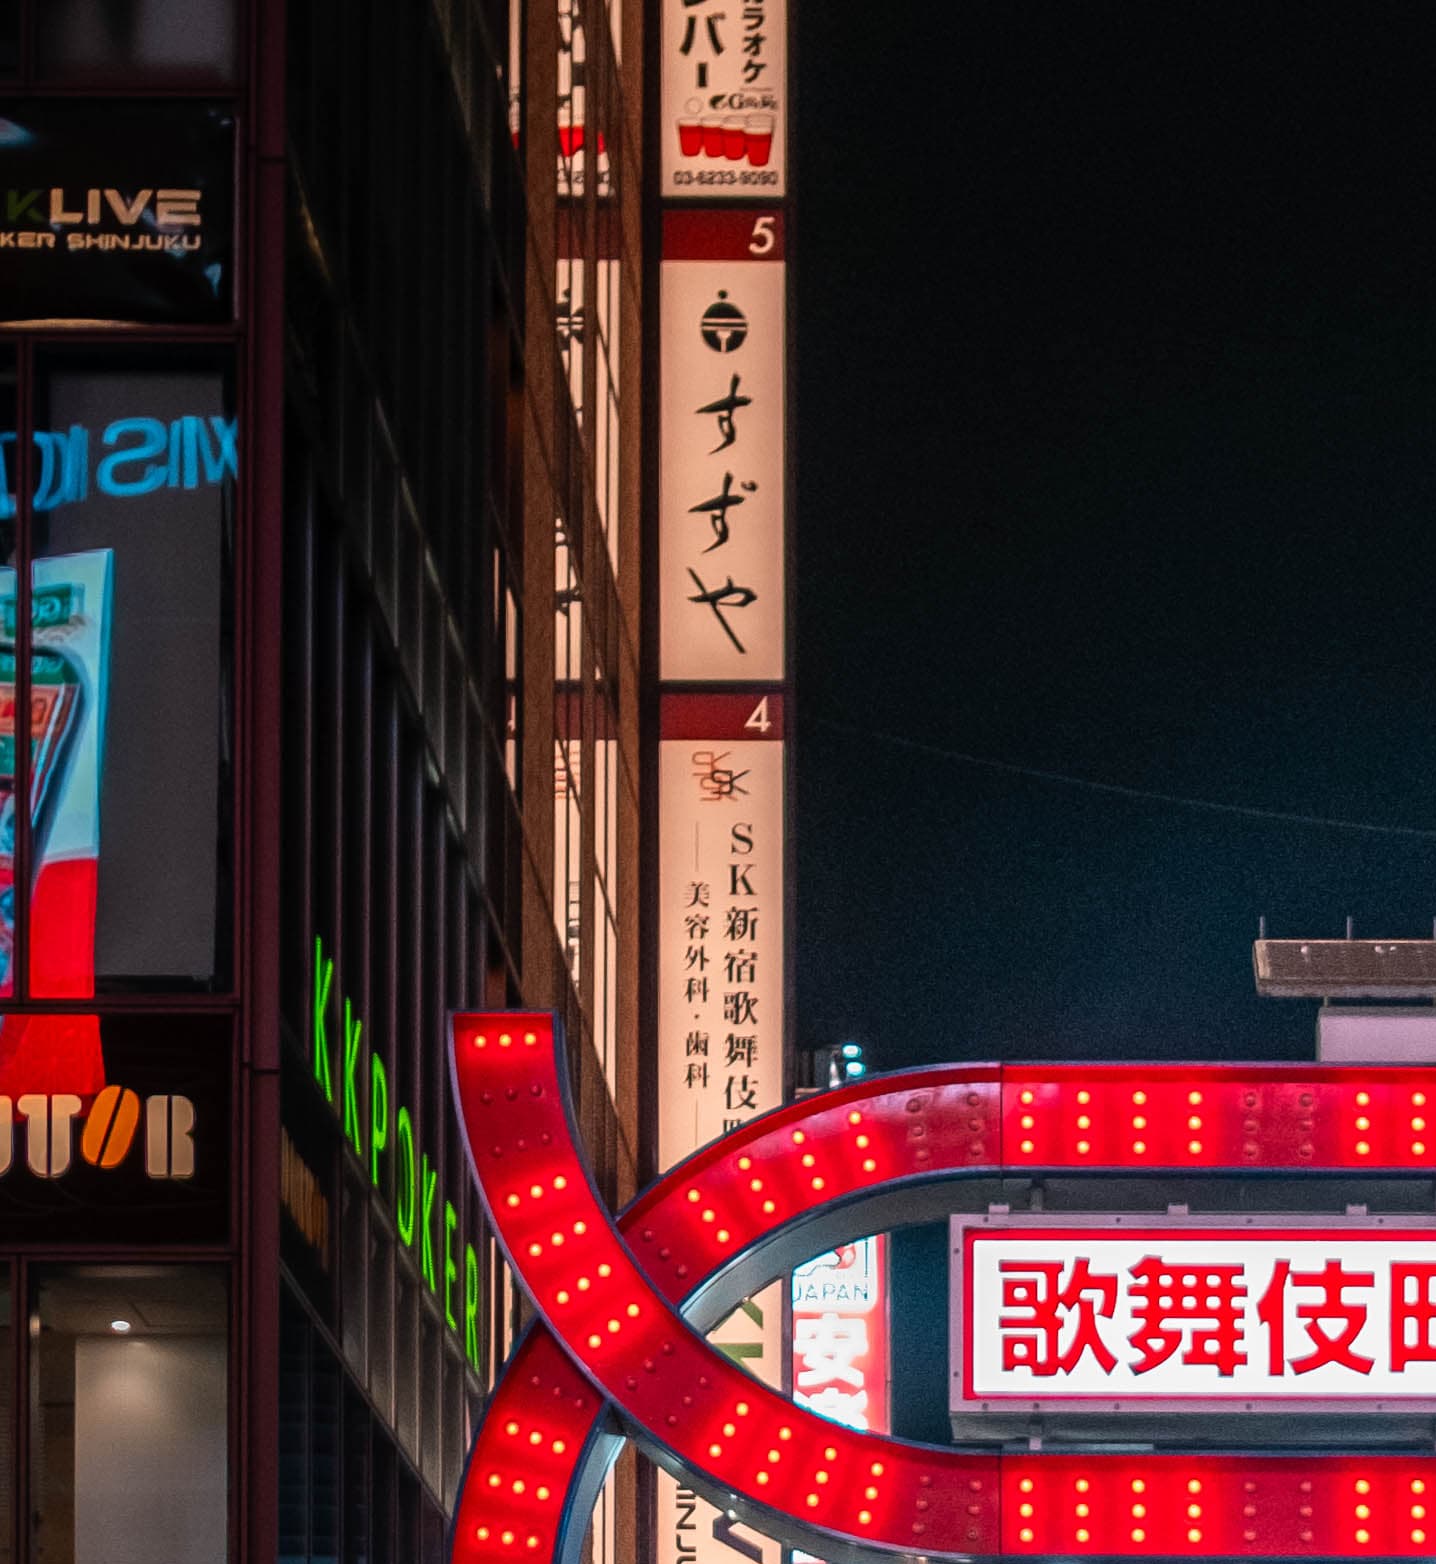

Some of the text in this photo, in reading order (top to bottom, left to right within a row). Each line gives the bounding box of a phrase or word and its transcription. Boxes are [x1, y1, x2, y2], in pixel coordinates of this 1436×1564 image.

[680, 0, 727, 88] バー
[66, 233, 202, 251] SHINJUKU
[748, 216, 776, 254] 5
[687, 373, 759, 655] すずや
[744, 695, 772, 733] 4
[683, 879, 711, 1091] 美容外科・歯科
[0, 1085, 196, 1180] TOR
[314, 934, 481, 1374] KKPOKER
